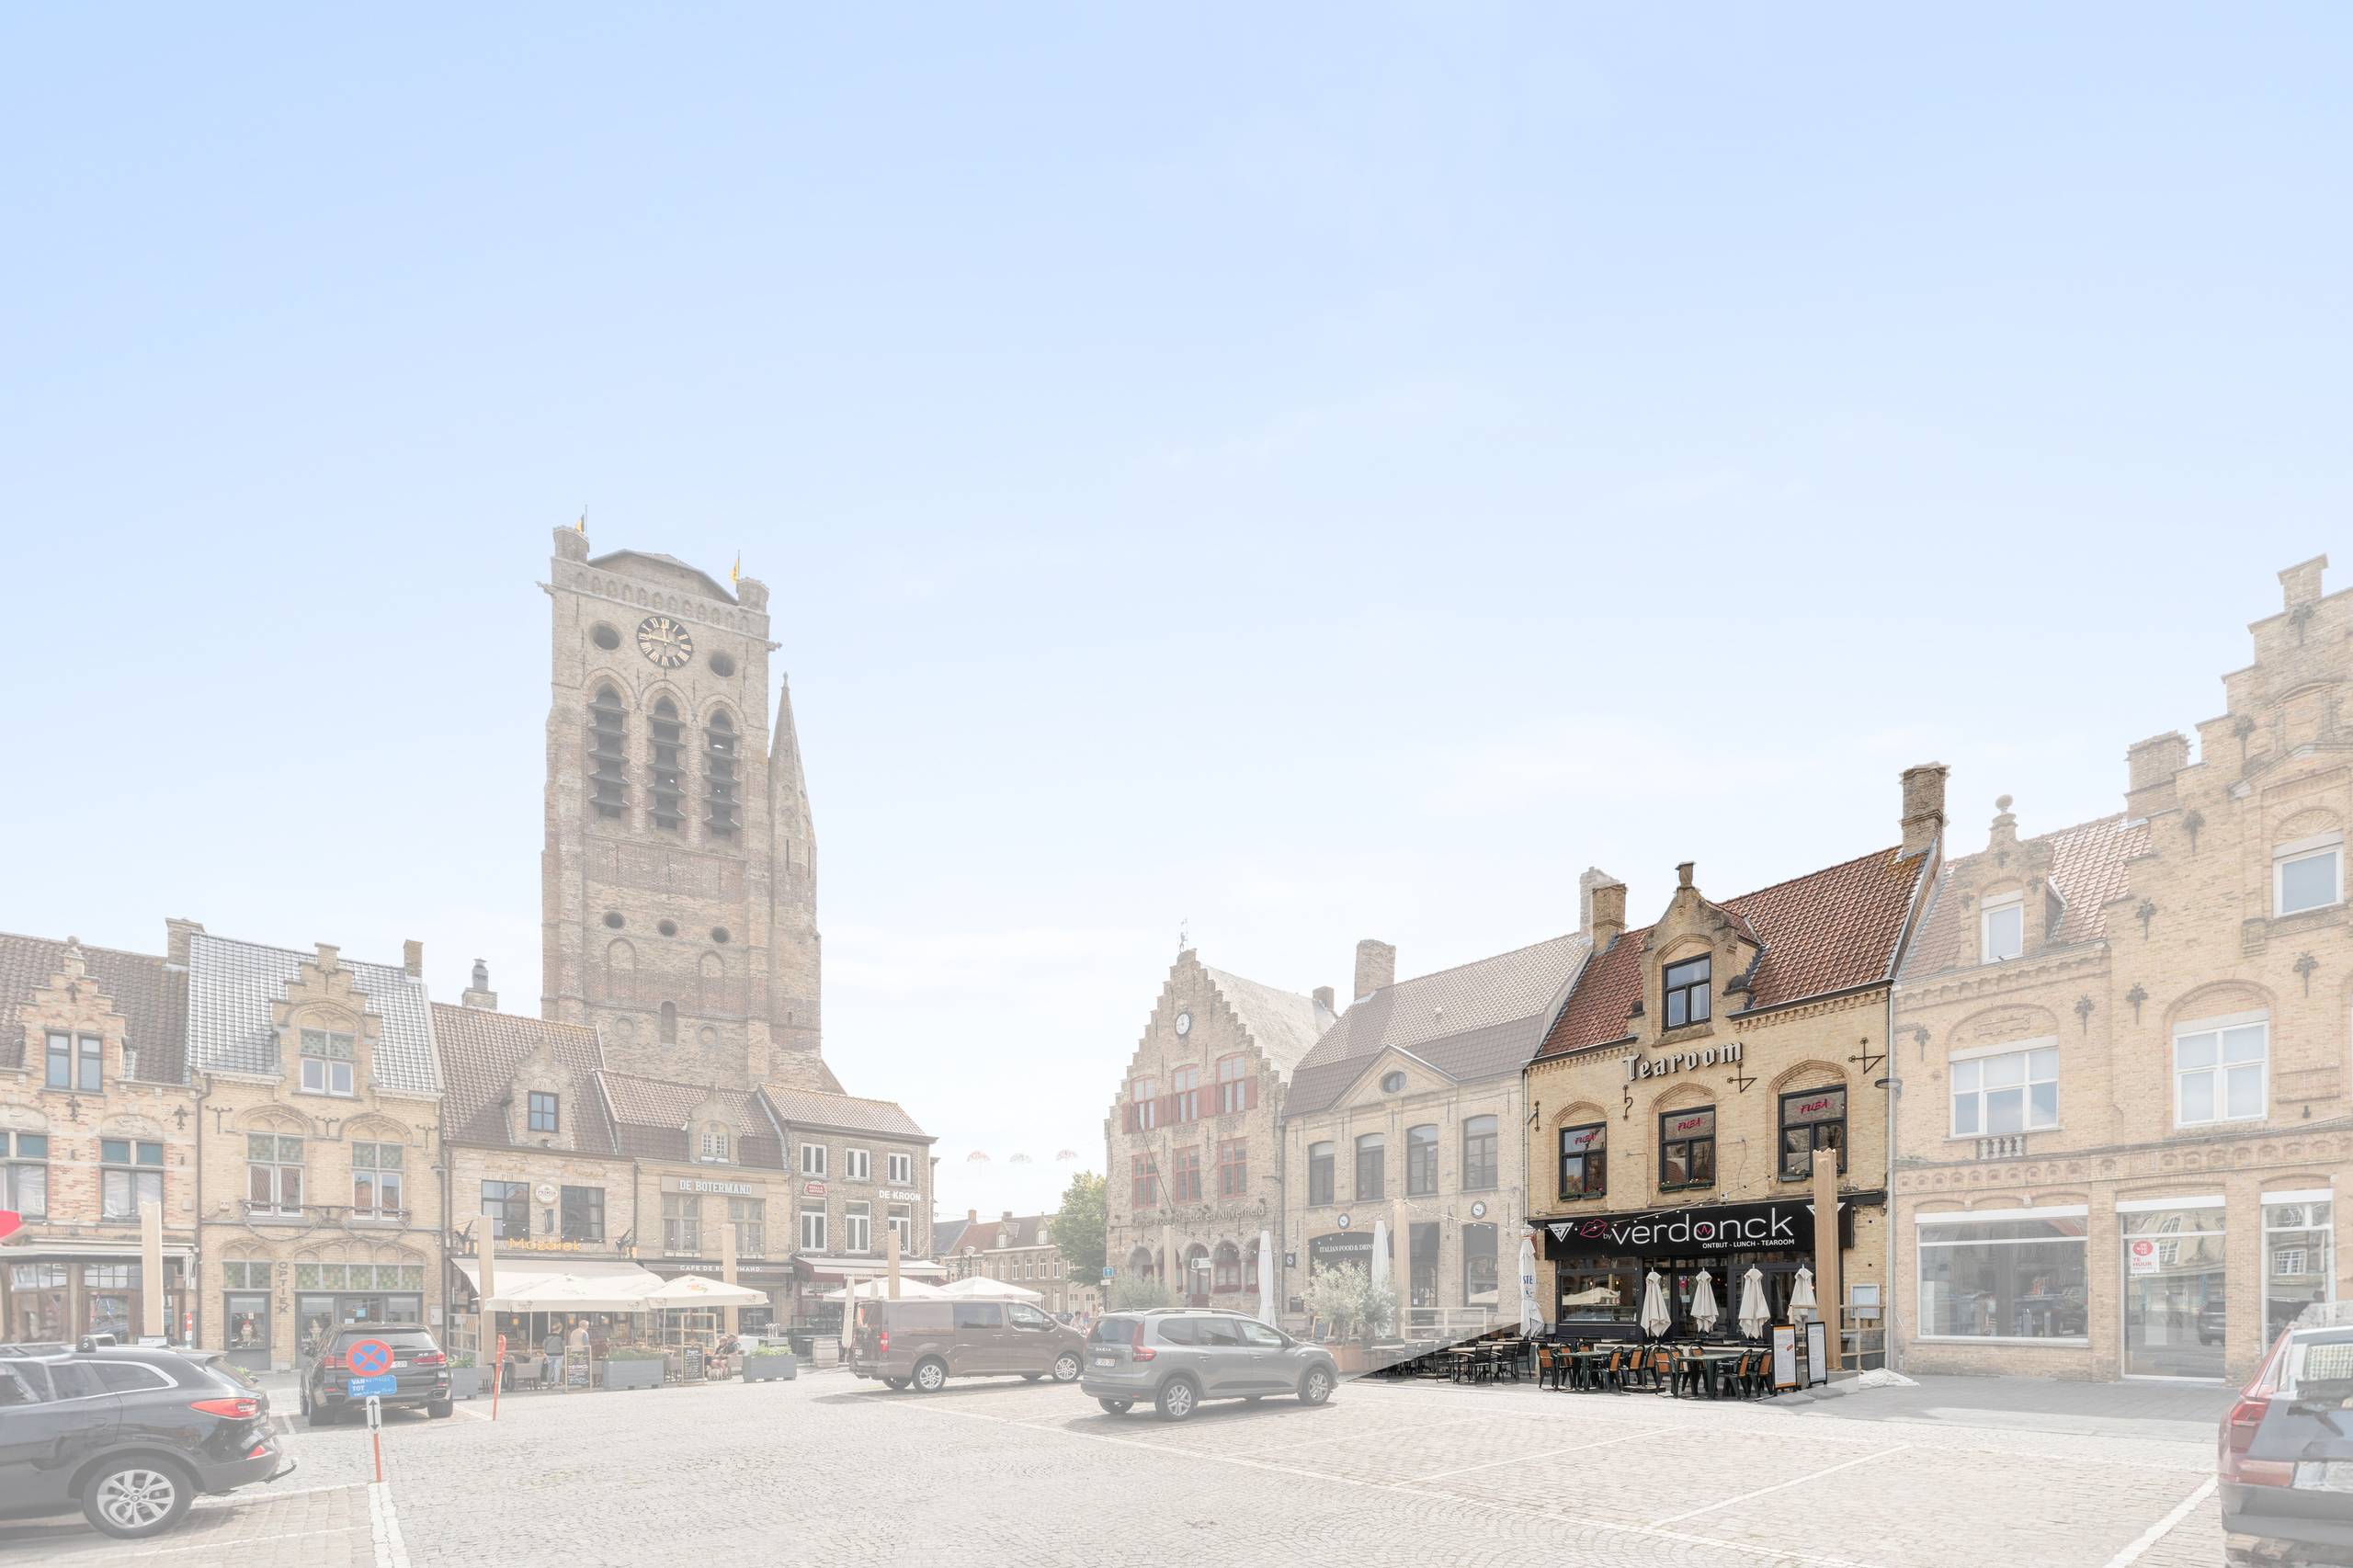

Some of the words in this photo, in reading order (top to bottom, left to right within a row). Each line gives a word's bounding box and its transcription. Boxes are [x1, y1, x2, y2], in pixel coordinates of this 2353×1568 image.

[1623, 1042, 1743, 1081] Tearoom
[679, 1179, 692, 1191] DE
[695, 1181, 752, 1195] BOTERMAND
[879, 1189, 891, 1199] DE
[892, 1190, 921, 1201] KROON
[1205, 1211, 1215, 1221] en
[1603, 1233, 1612, 1241] by
[1611, 1208, 1793, 1244] verdonck
[1319, 1244, 1339, 1253] ITALIAN
[278, 1261, 289, 1313] OPTIEK
